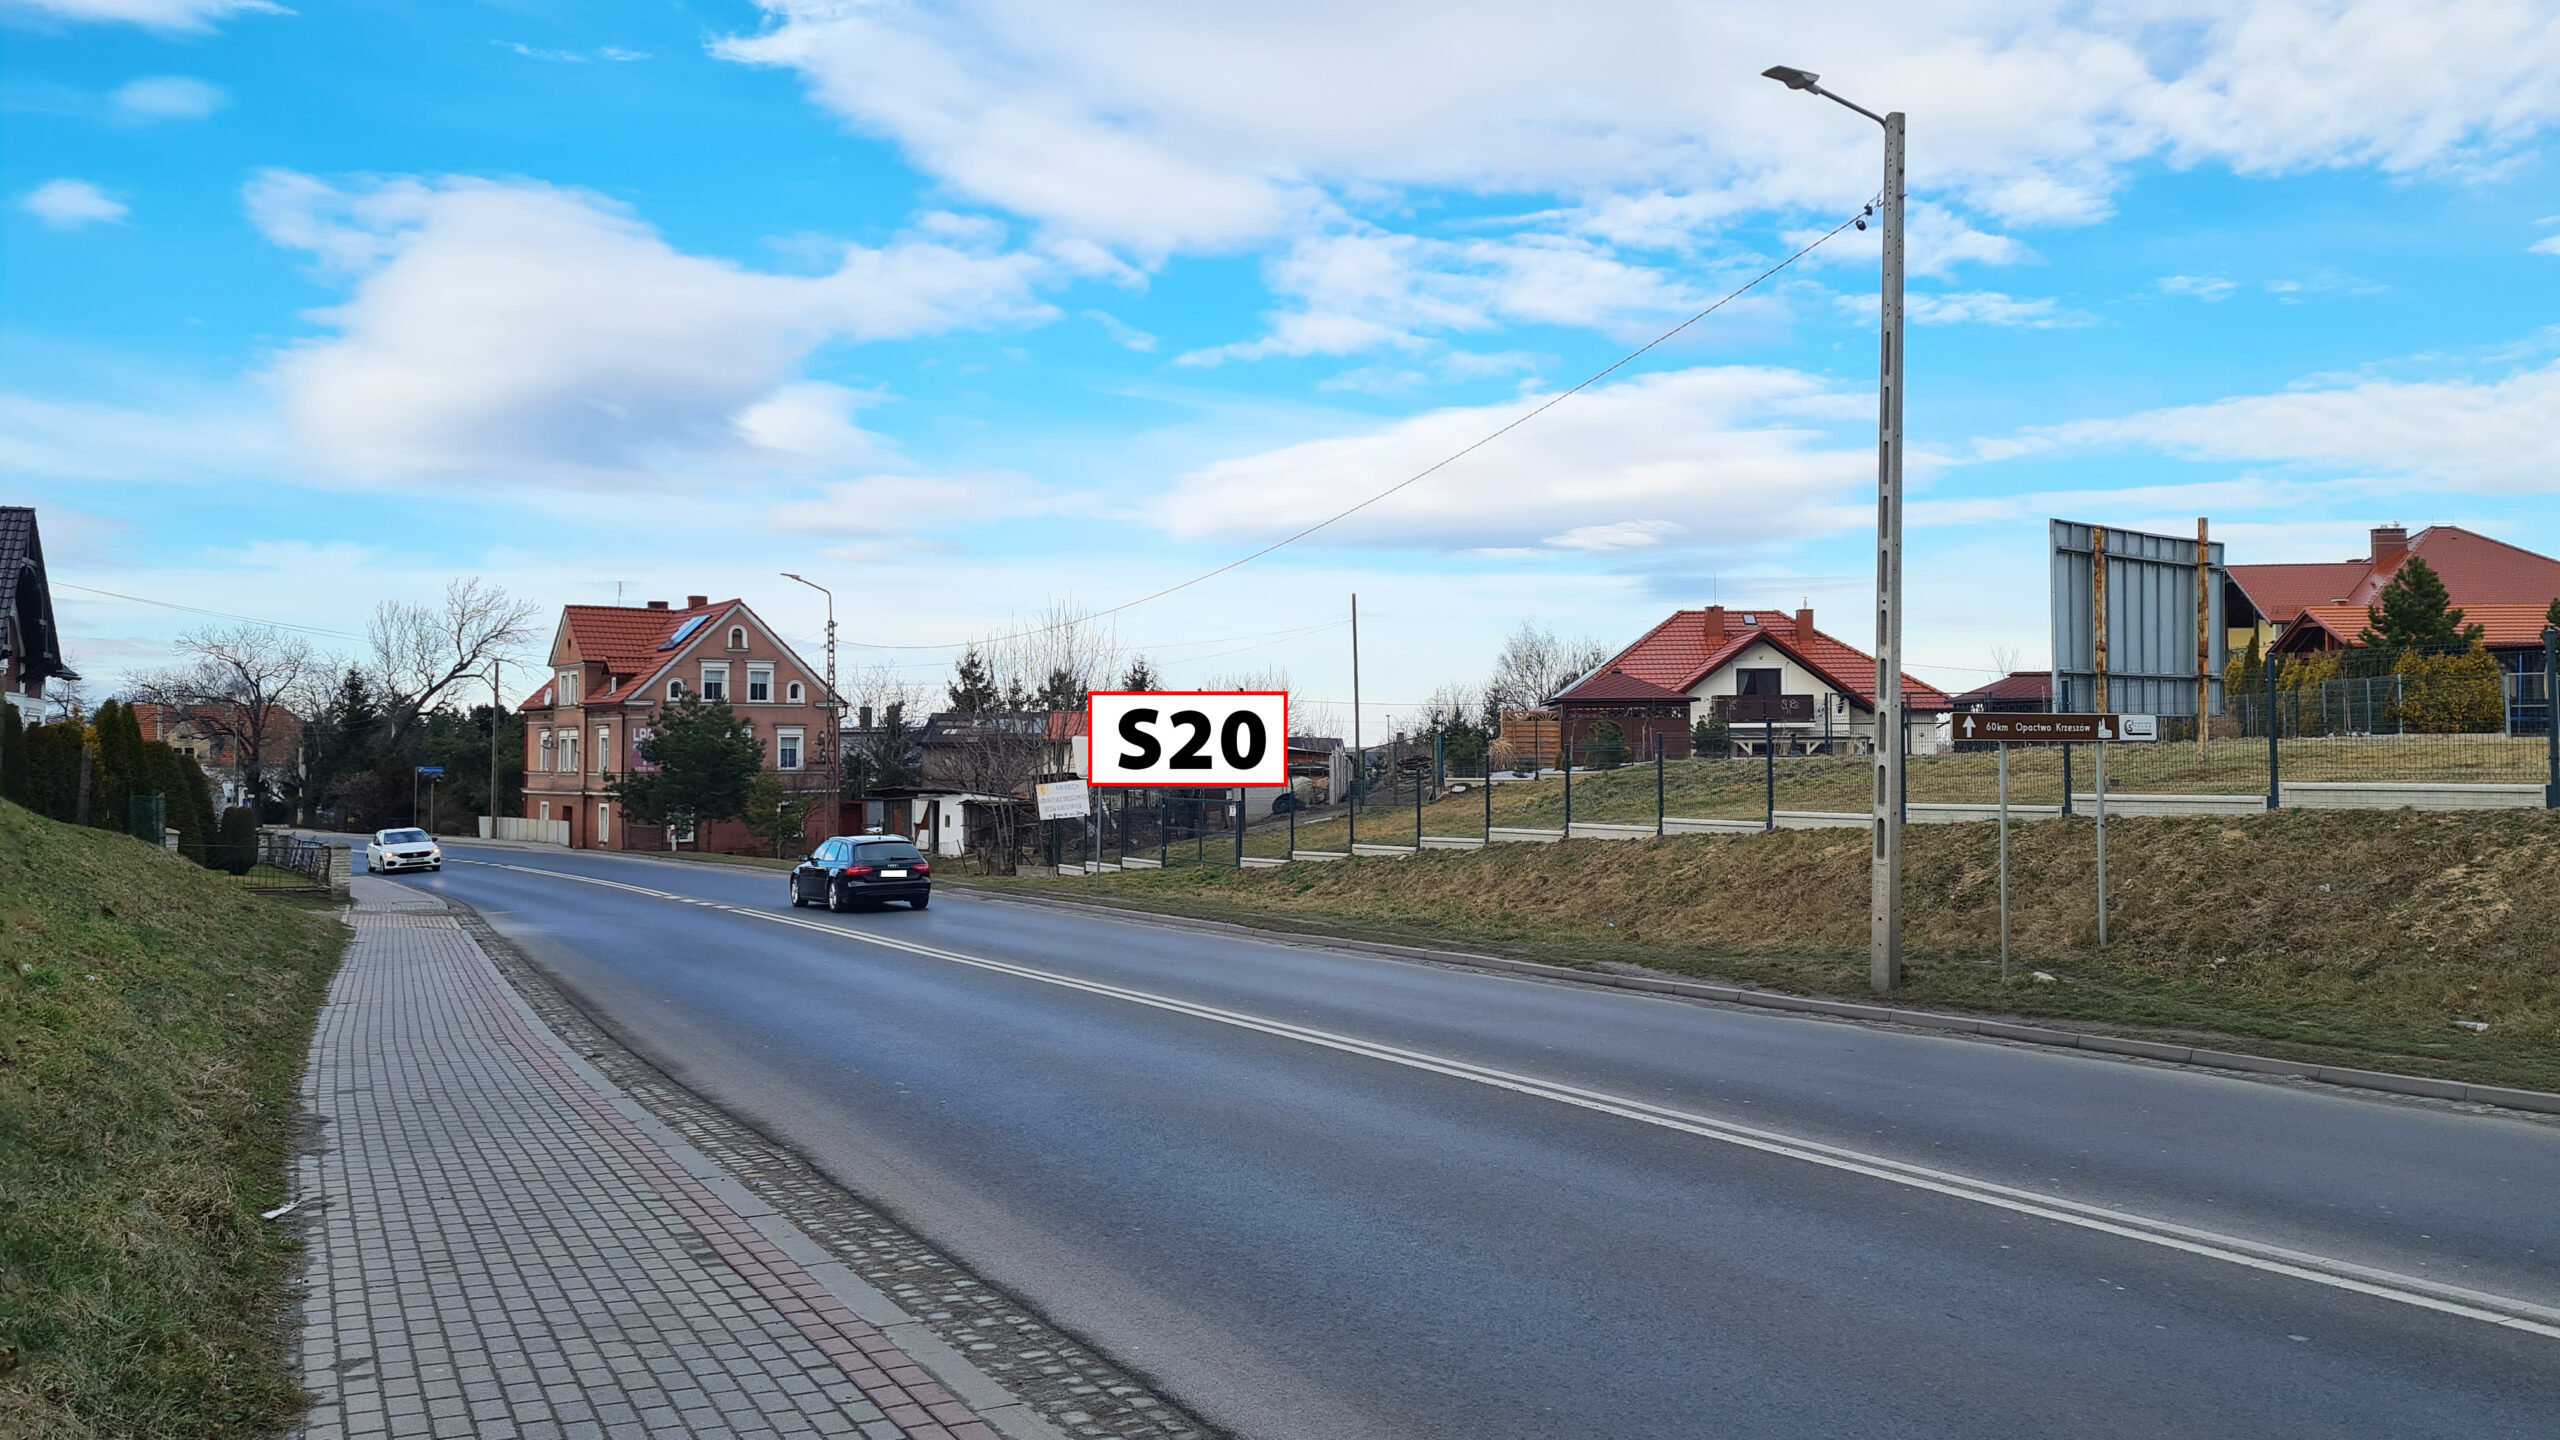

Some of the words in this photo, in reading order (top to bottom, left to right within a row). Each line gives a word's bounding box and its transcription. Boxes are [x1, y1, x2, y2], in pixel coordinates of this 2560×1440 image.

[1986, 721, 2009, 732] 60km
[2015, 722, 2052, 734] Opactwo
[2055, 721, 2091, 732] Krzeszów
